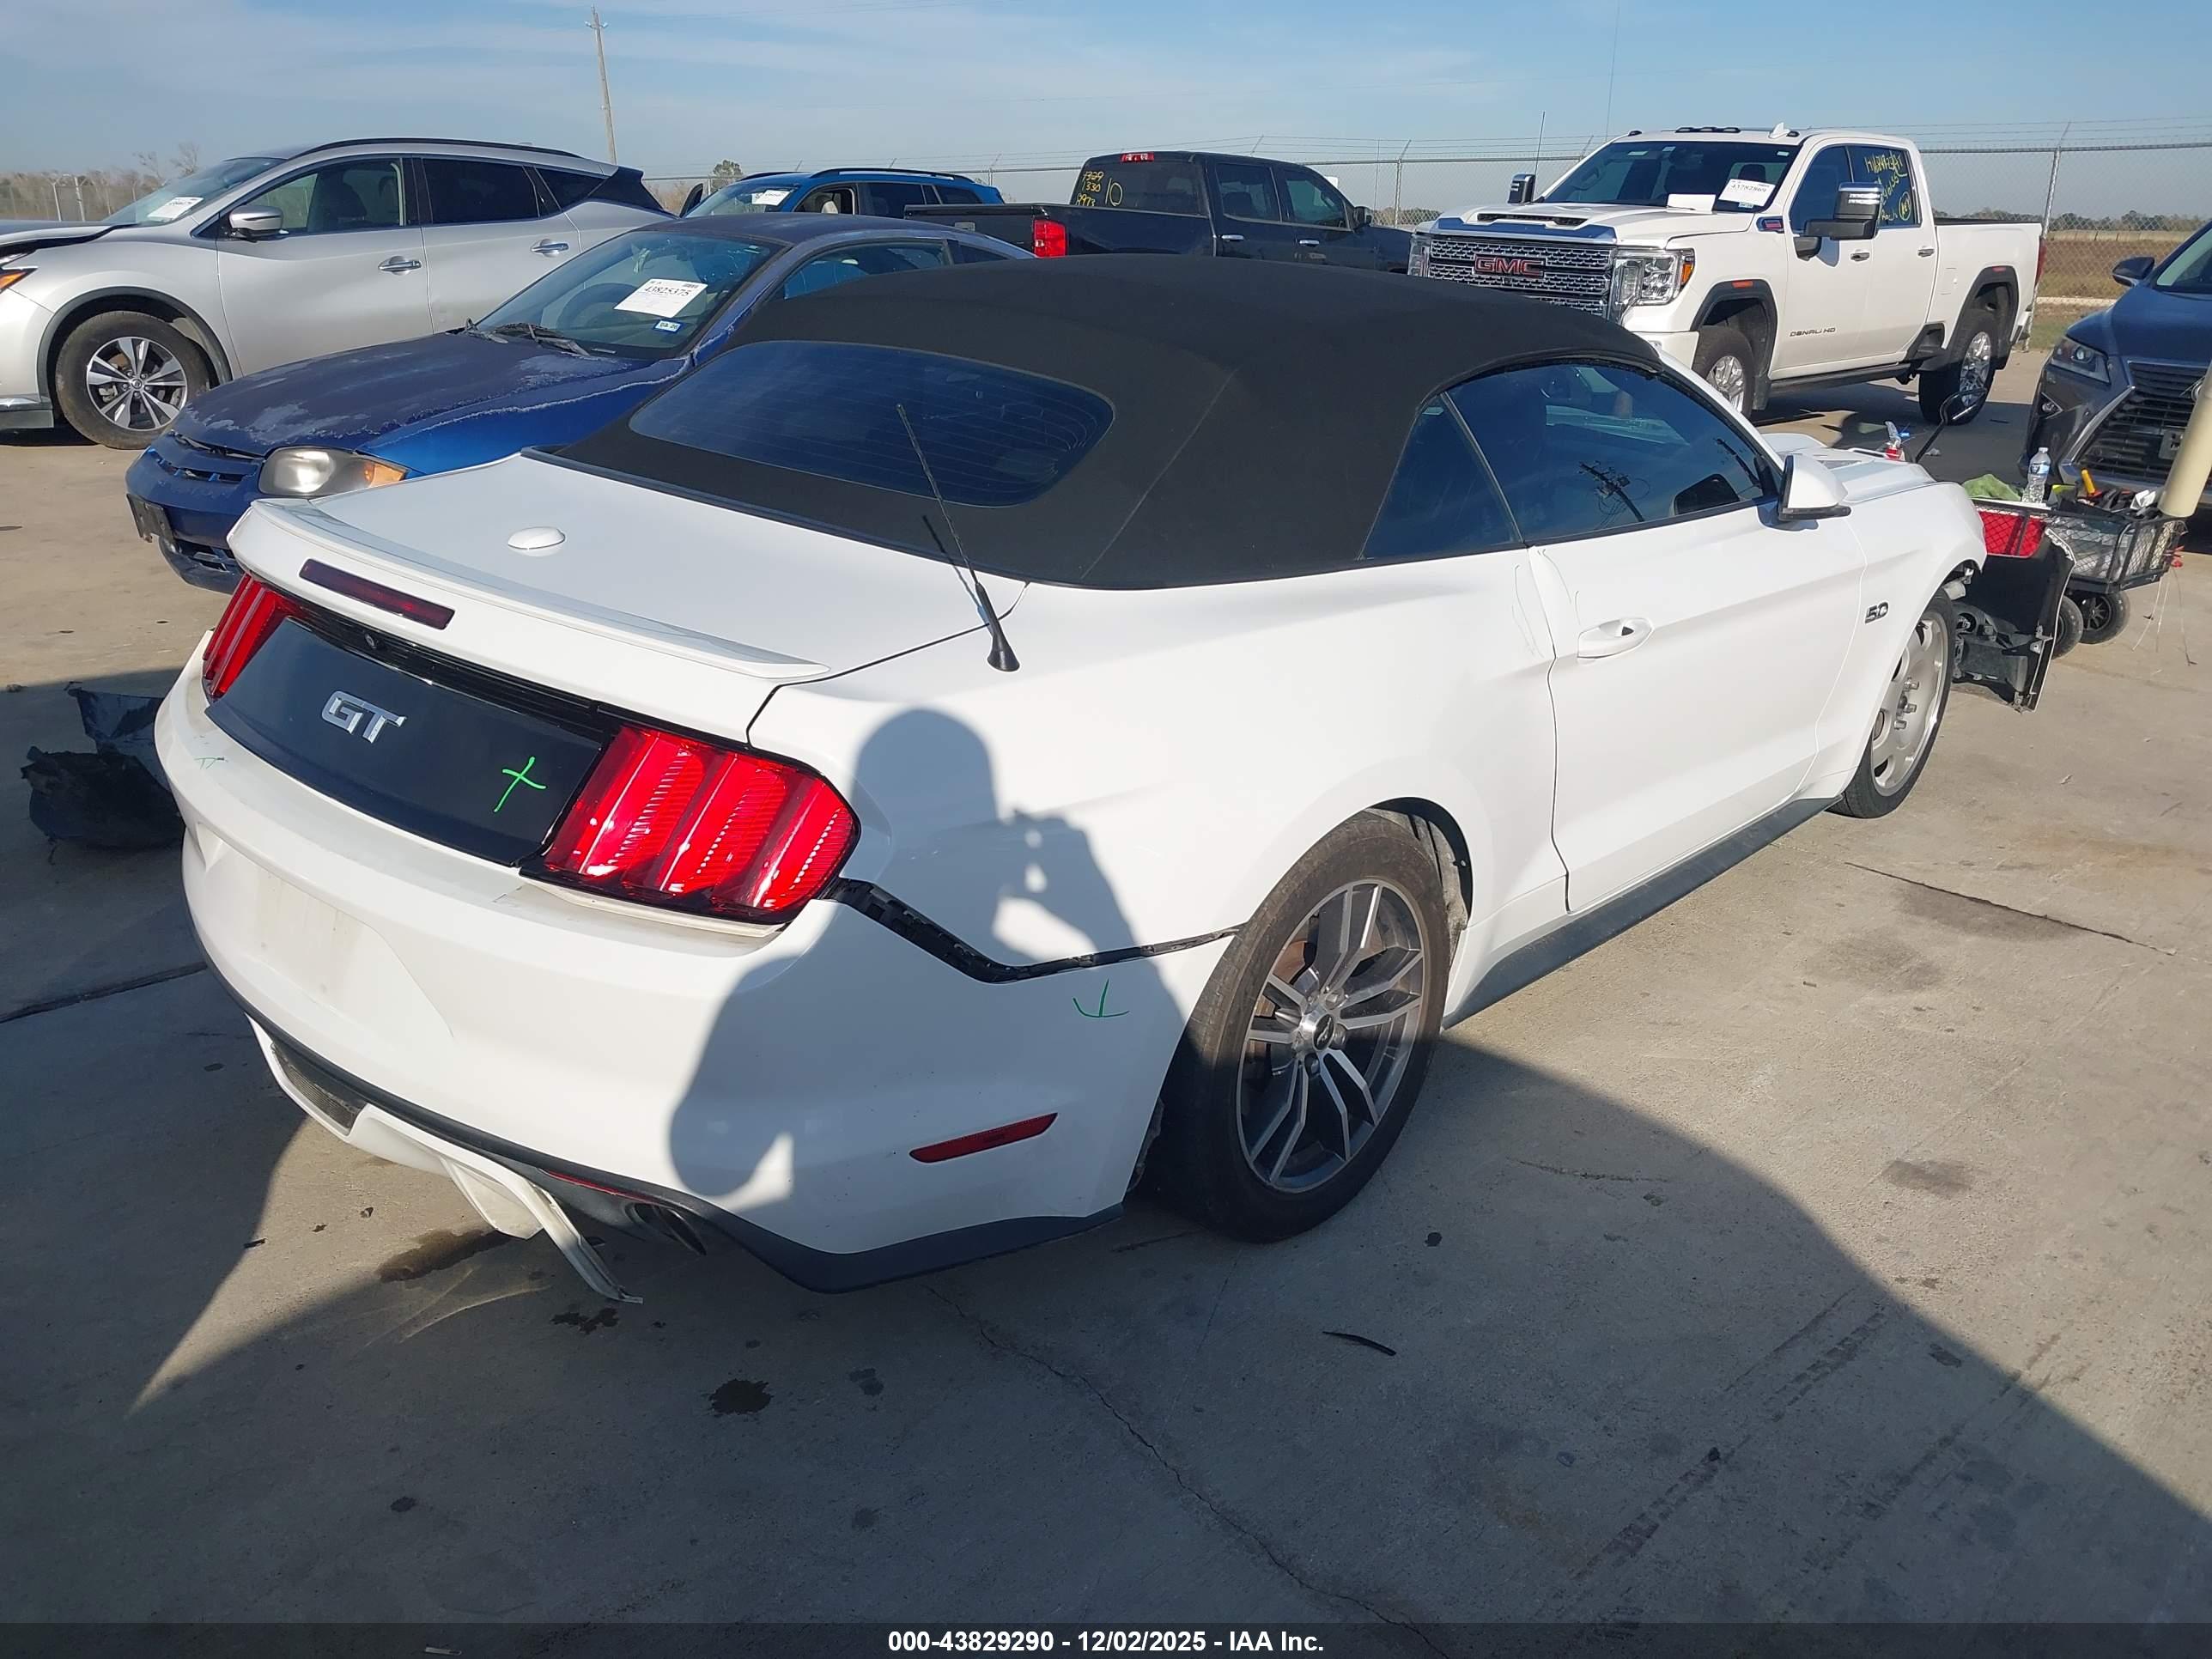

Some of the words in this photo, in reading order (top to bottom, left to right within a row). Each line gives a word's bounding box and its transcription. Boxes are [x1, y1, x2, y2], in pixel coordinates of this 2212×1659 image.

[1082, 180, 1101, 192] 1330
[1105, 178, 1123, 207] 10
[1475, 256, 1544, 277] GMC
[321, 690, 407, 744] GT
